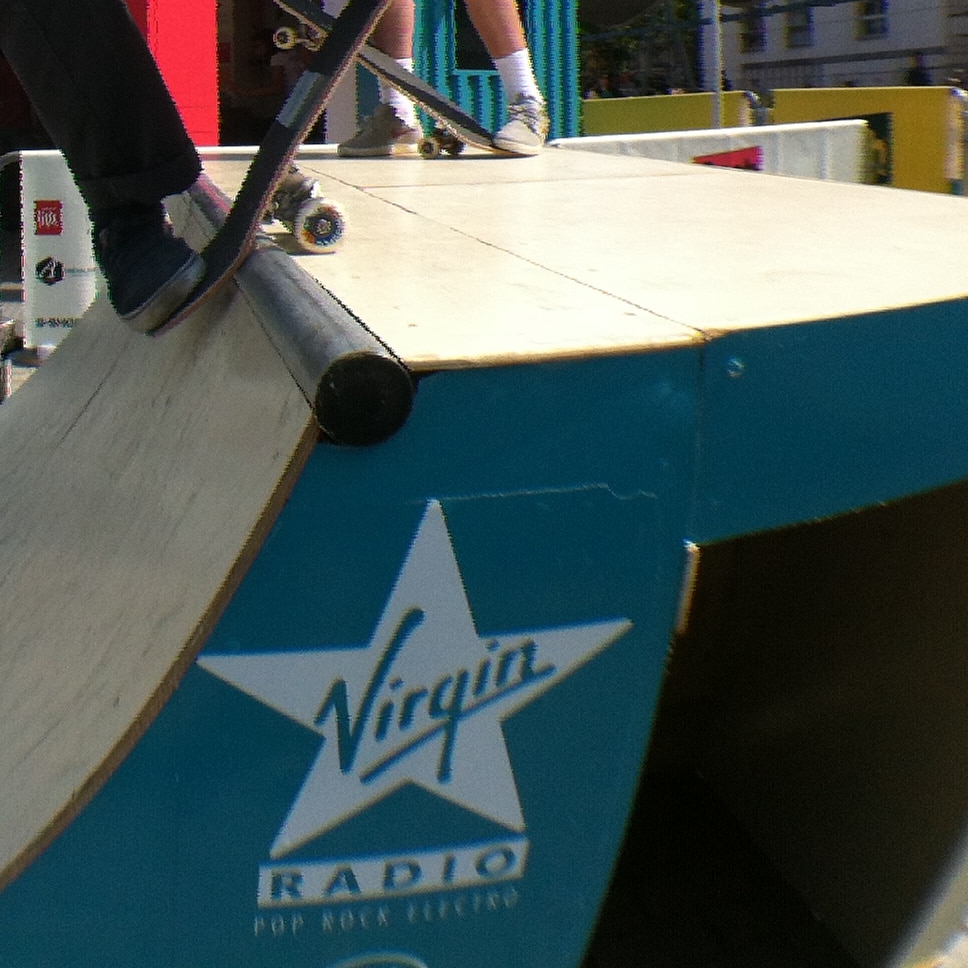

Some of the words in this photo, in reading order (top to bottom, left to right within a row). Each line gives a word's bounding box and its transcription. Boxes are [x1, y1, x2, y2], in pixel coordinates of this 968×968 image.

[313, 606, 558, 785] Virgin
[269, 846, 519, 901] RADIO
[253, 914, 304, 936] POP
